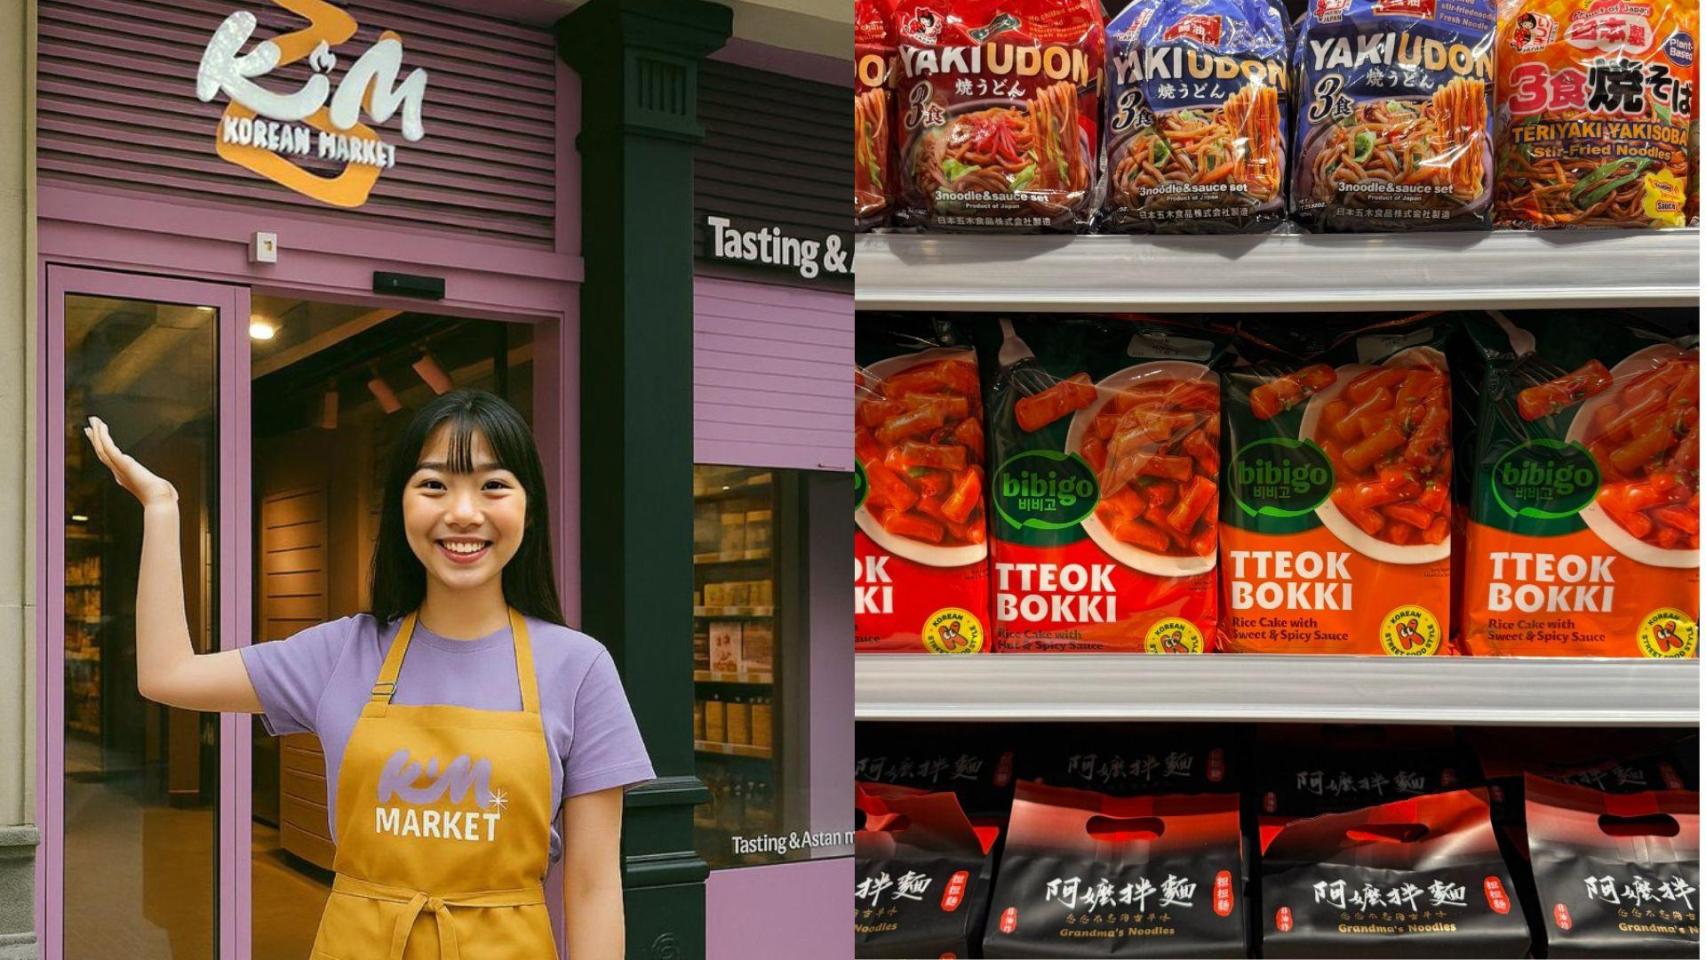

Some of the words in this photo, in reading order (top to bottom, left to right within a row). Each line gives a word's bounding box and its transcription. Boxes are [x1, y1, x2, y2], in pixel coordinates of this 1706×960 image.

[1366, 67, 1435, 89] 焼うどん
[955, 78, 1026, 97] 焼うどん
[1158, 84, 1225, 99] 焼うどん
[1512, 119, 1602, 145] TERIYAKI
[1609, 121, 1688, 147] YAKISOBA
[223, 116, 310, 154] KOREAN
[318, 131, 396, 167] MARKET
[1533, 144, 1615, 158] Stir-Fried
[1616, 145, 1671, 160] Noodles
[1229, 183, 1248, 193] set
[1338, 182, 1431, 194] 3noodle&sauce
[1434, 184, 1453, 194] set
[708, 216, 820, 278] Tasting
[824, 234, 848, 273] &
[1239, 458, 1328, 494] bibigo
[1502, 460, 1594, 496] bibigo
[1003, 470, 1094, 506] bibigo
[1253, 486, 1290, 499] 비비고
[1515, 487, 1554, 500] 비비고
[1018, 498, 1056, 512] 비비고
[1230, 550, 1352, 580] TTEOK
[1489, 551, 1617, 583] TTEOK
[995, 563, 1116, 592] TTEOK
[1231, 581, 1352, 610] BOKKI
[1487, 582, 1615, 613] BOKKI
[997, 593, 1117, 623] BOKKI
[932, 613, 963, 627] KOREAN
[1232, 616, 1256, 627] Rice
[1259, 616, 1287, 627] Cake
[1290, 617, 1318, 628] with
[1390, 610, 1422, 624] KOREAN
[1488, 618, 1514, 629] Rice
[1516, 619, 1545, 629] Cake
[1547, 618, 1575, 629] with
[1648, 613, 1680, 626] KOREAN
[1155, 623, 1185, 636] KOREAN
[1232, 629, 1267, 639] Sweet
[1269, 629, 1279, 641] &
[1280, 629, 1311, 642] Spicy
[1314, 630, 1349, 641] Sauce
[1425, 623, 1436, 649] STYLE
[1488, 630, 1523, 641] Sweet
[1526, 630, 1536, 642] &
[1537, 630, 1569, 643] Spicy
[1571, 631, 1606, 642] Sauce
[1035, 641, 1065, 651] Spicy
[1069, 642, 1104, 650] Sauce
[375, 807, 500, 841] MARKET
[731, 834, 787, 854] Tasting
[789, 831, 801, 849] &
[1060, 927, 1123, 938] Grandma's
[1128, 925, 1175, 936] Noodles
[1338, 922, 1404, 933] Grandma's
[1408, 922, 1456, 933] Noodles
[1618, 922, 1686, 934] Grandma's
